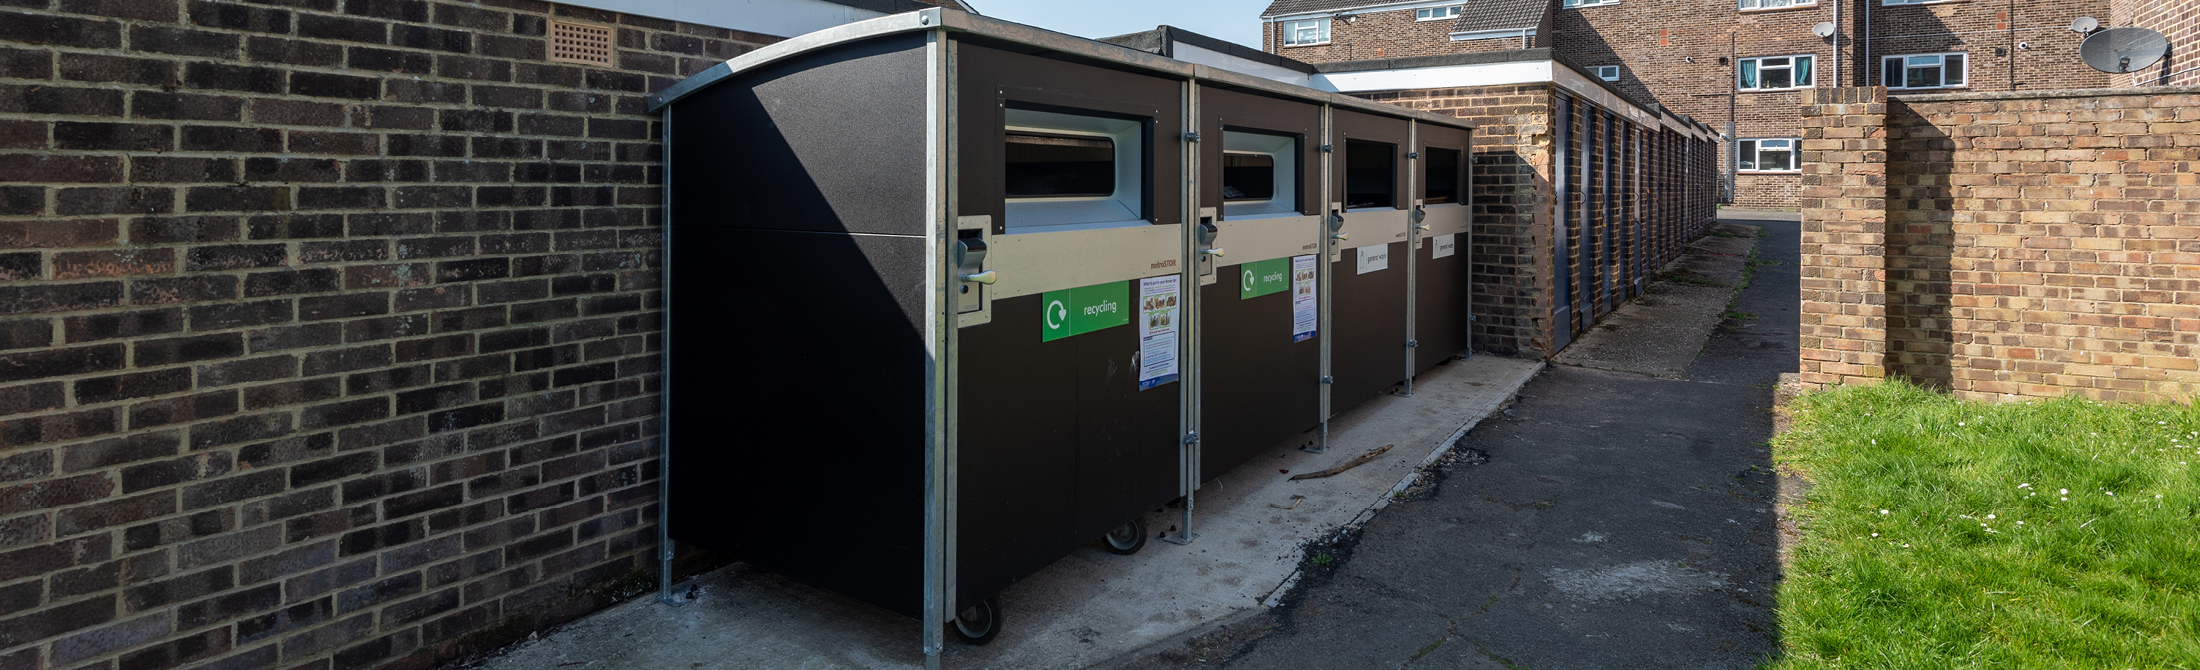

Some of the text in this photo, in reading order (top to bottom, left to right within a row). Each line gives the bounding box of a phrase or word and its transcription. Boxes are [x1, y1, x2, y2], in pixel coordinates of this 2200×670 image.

[1150, 259, 1177, 269] metroSTOR
[1263, 271, 1282, 283] recycling
[1083, 300, 1117, 316] recycling
